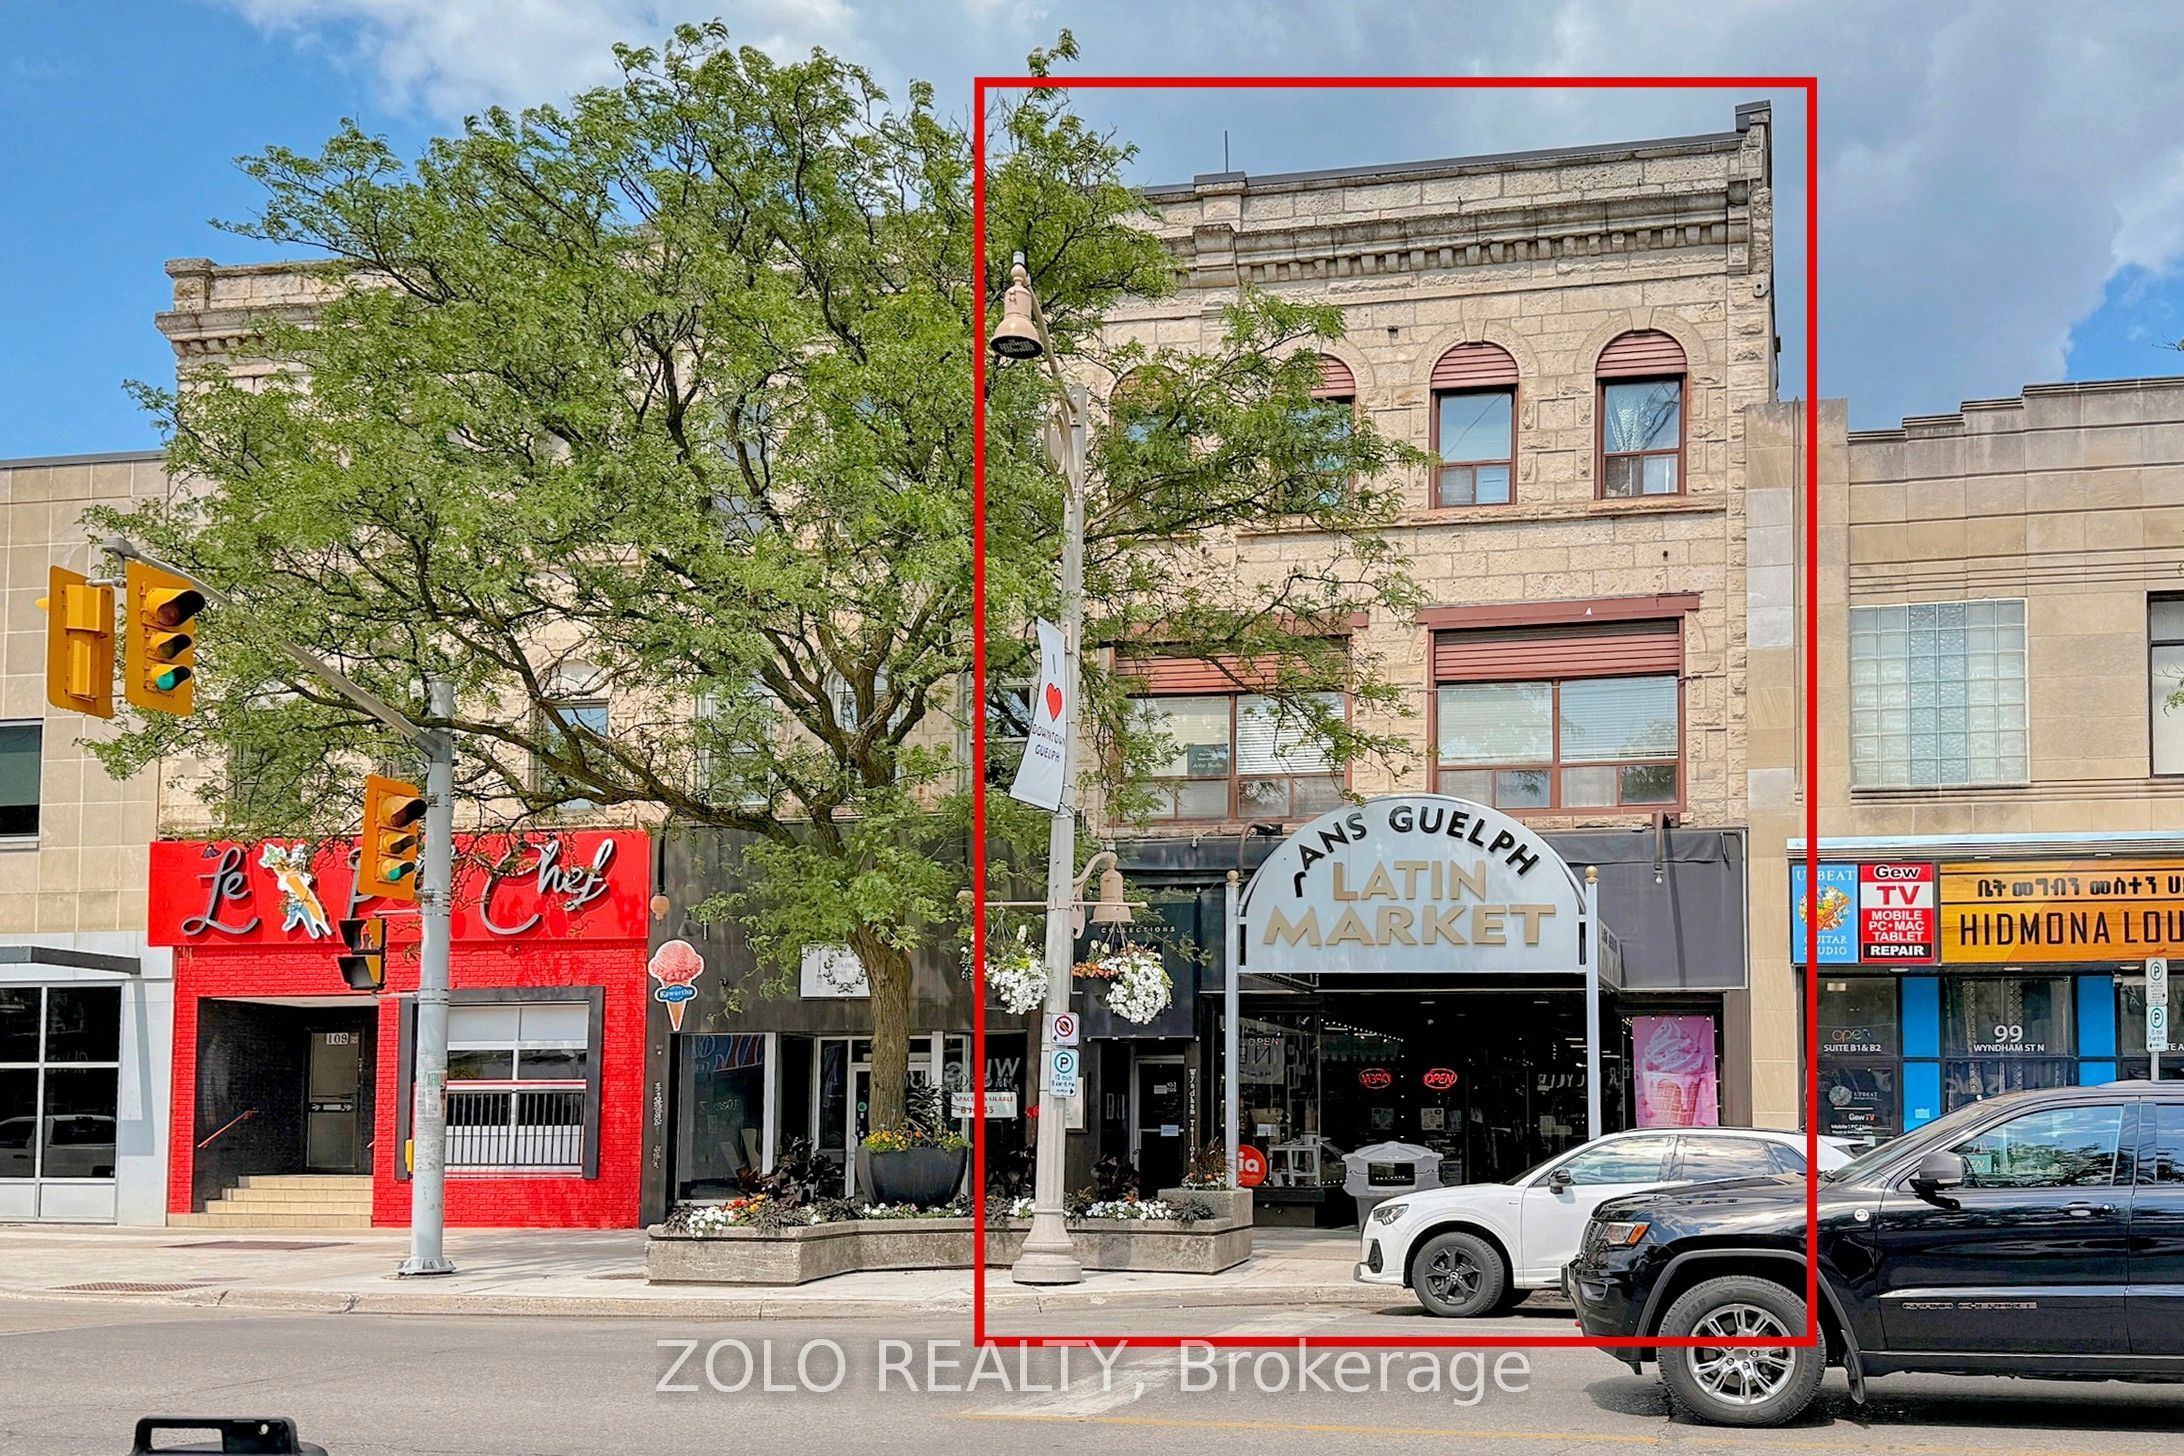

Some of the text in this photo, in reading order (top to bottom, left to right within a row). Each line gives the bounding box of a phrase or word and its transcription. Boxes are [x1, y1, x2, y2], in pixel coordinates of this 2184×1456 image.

[1031, 723, 1066, 746] DOWNTOWN
[1034, 744, 1061, 763] GUELPH
[1388, 805, 1540, 876] GUELPH
[1796, 870, 1856, 881] UBEAT
[1874, 865, 1919, 878] Gew
[481, 838, 615, 935] Chef
[1333, 860, 1487, 901] LATIN
[181, 846, 260, 936] Le
[1876, 886, 1920, 905] TV
[1871, 910, 1923, 921] MOBILE
[1263, 904, 1557, 946] MARKET
[1960, 911, 2111, 946] HIDMONA
[1872, 931, 1924, 942] TABLET
[1870, 945, 1925, 956] REPAIR
[328, 1033, 347, 1043] 109
[1994, 1025, 2023, 1043] 99
[1249, 1038, 1280, 1046] OPEN
[1824, 1044, 1849, 1052] SUITE
[1974, 1044, 2045, 1052] WYNDHAM ST N
[1424, 1073, 1454, 1084] OPEN
